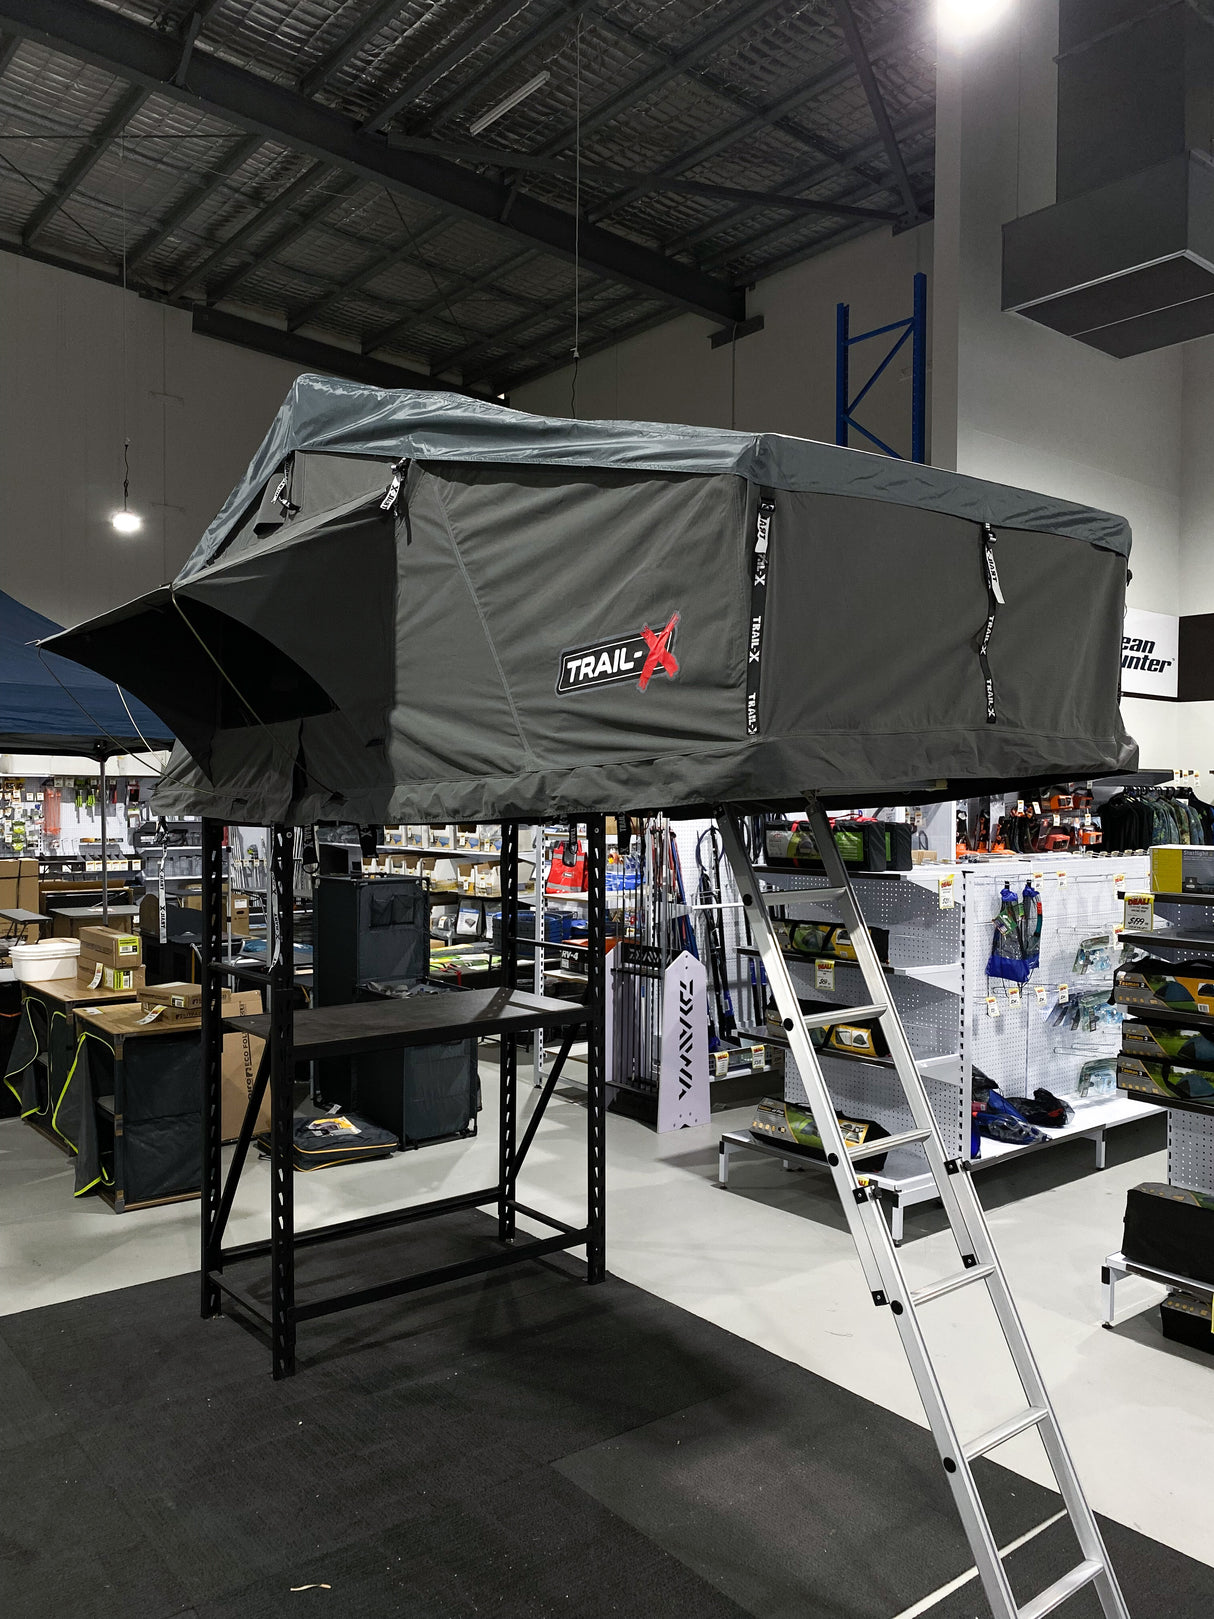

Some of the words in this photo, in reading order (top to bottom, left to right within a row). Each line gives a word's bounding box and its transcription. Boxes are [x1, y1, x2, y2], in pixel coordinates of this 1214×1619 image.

[566, 612, 679, 690] TRAIL-X
[748, 616, 762, 664] TRAIL-X
[980, 615, 995, 656] TRAIL-X
[986, 679, 996, 717] TRAIL-X
[561, 950, 580, 960] RV-4
